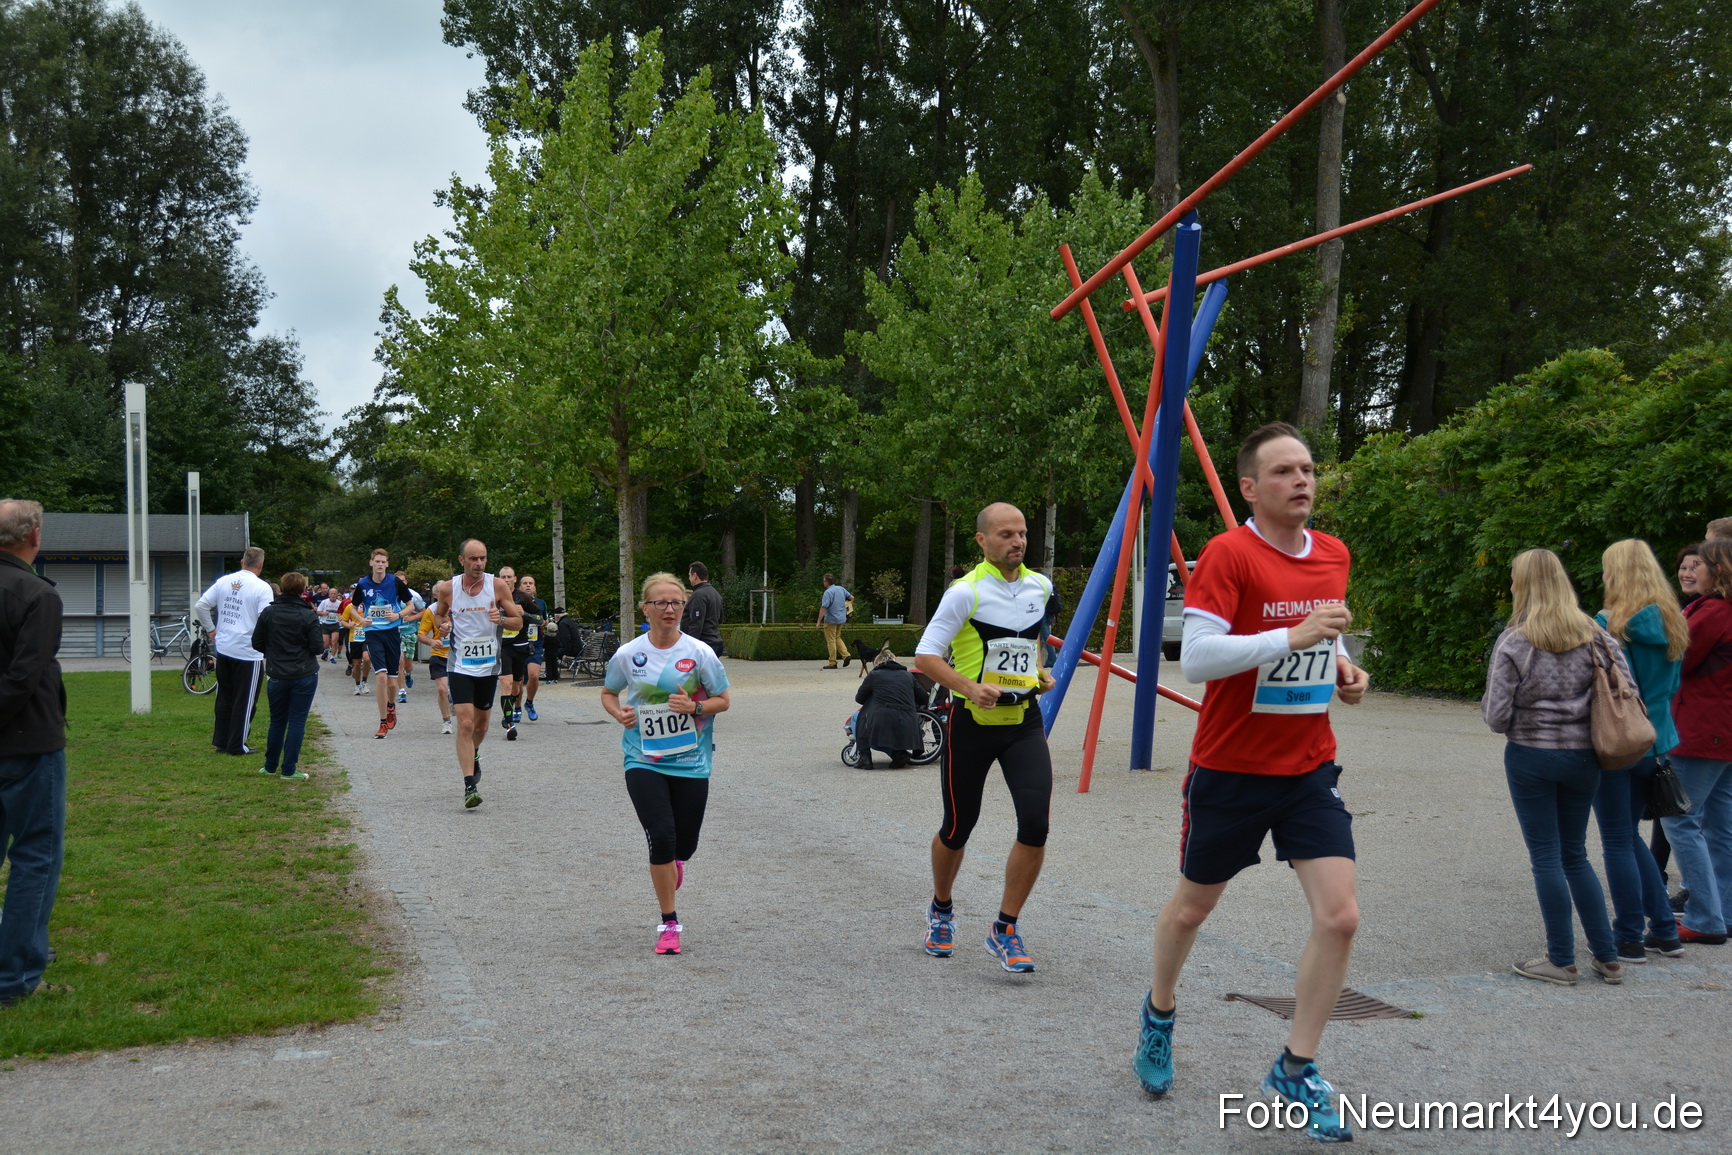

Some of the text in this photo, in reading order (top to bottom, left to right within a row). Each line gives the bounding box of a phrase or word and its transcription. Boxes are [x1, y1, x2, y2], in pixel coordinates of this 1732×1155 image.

[362, 588, 374, 597] 14
[464, 644, 492, 657] 2411
[997, 650, 1028, 673] 213
[1267, 650, 1330, 682] 2277
[998, 676, 1026, 687] Thomas
[1286, 690, 1311, 702] Sven
[645, 714, 690, 736] 3102
